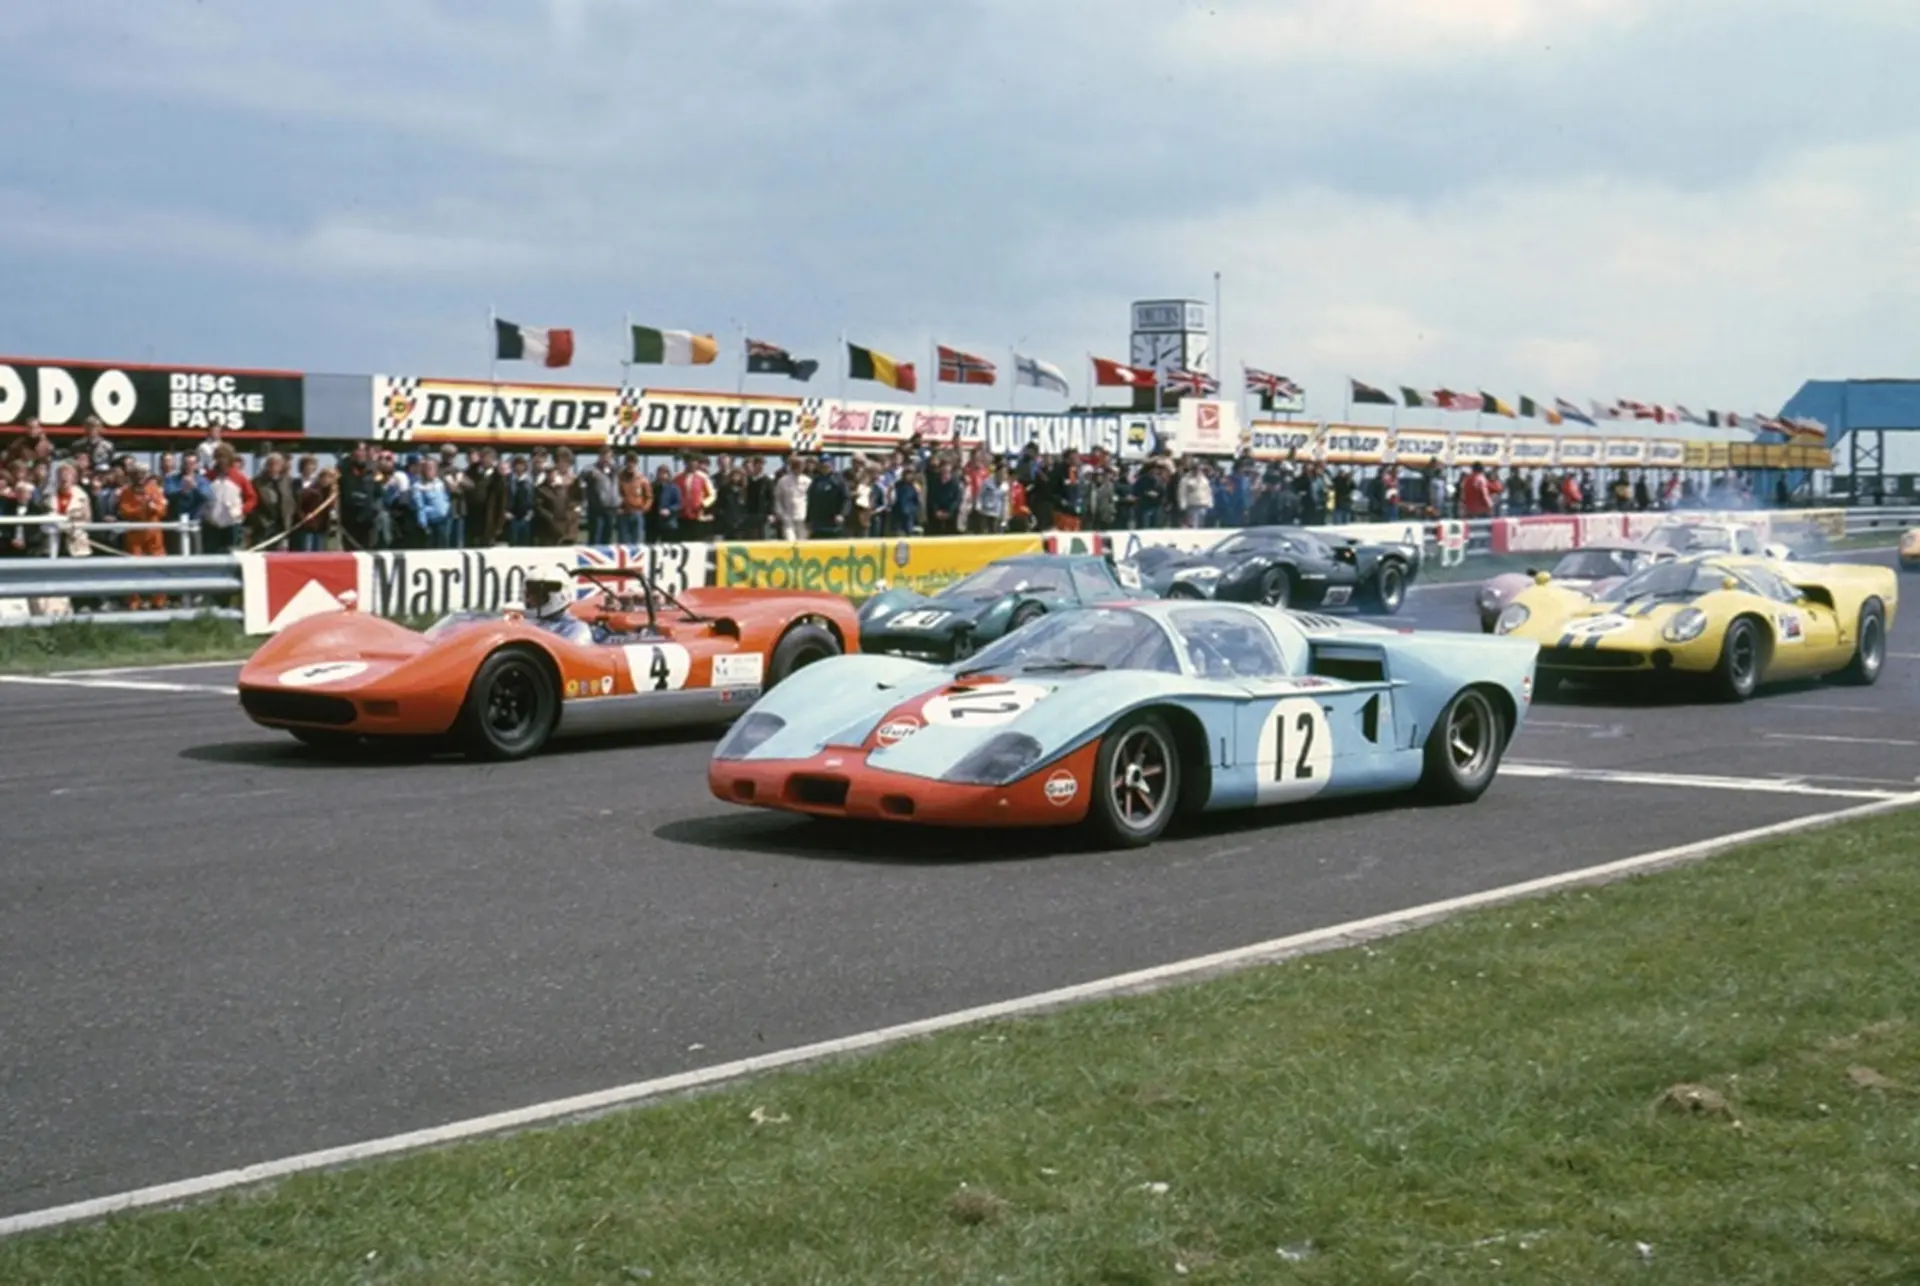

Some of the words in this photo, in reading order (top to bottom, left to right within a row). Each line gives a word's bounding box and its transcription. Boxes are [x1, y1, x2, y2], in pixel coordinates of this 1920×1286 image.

[170, 373, 236, 393] DISC
[170, 392, 264, 412] BRAKE
[421, 393, 607, 430] DUNLOP
[644, 403, 793, 436] DUNLOP
[872, 410, 903, 433] GTX
[953, 414, 979, 437] GTX
[1253, 433, 1309, 450] DUNLOP
[1328, 435, 1380, 452] DUNLOP
[727, 542, 886, 593] Protectol
[370, 550, 568, 618] Marlbo
[650, 646, 670, 691] 4
[947, 690, 1021, 719] 12
[1275, 712, 1314, 782] 12
